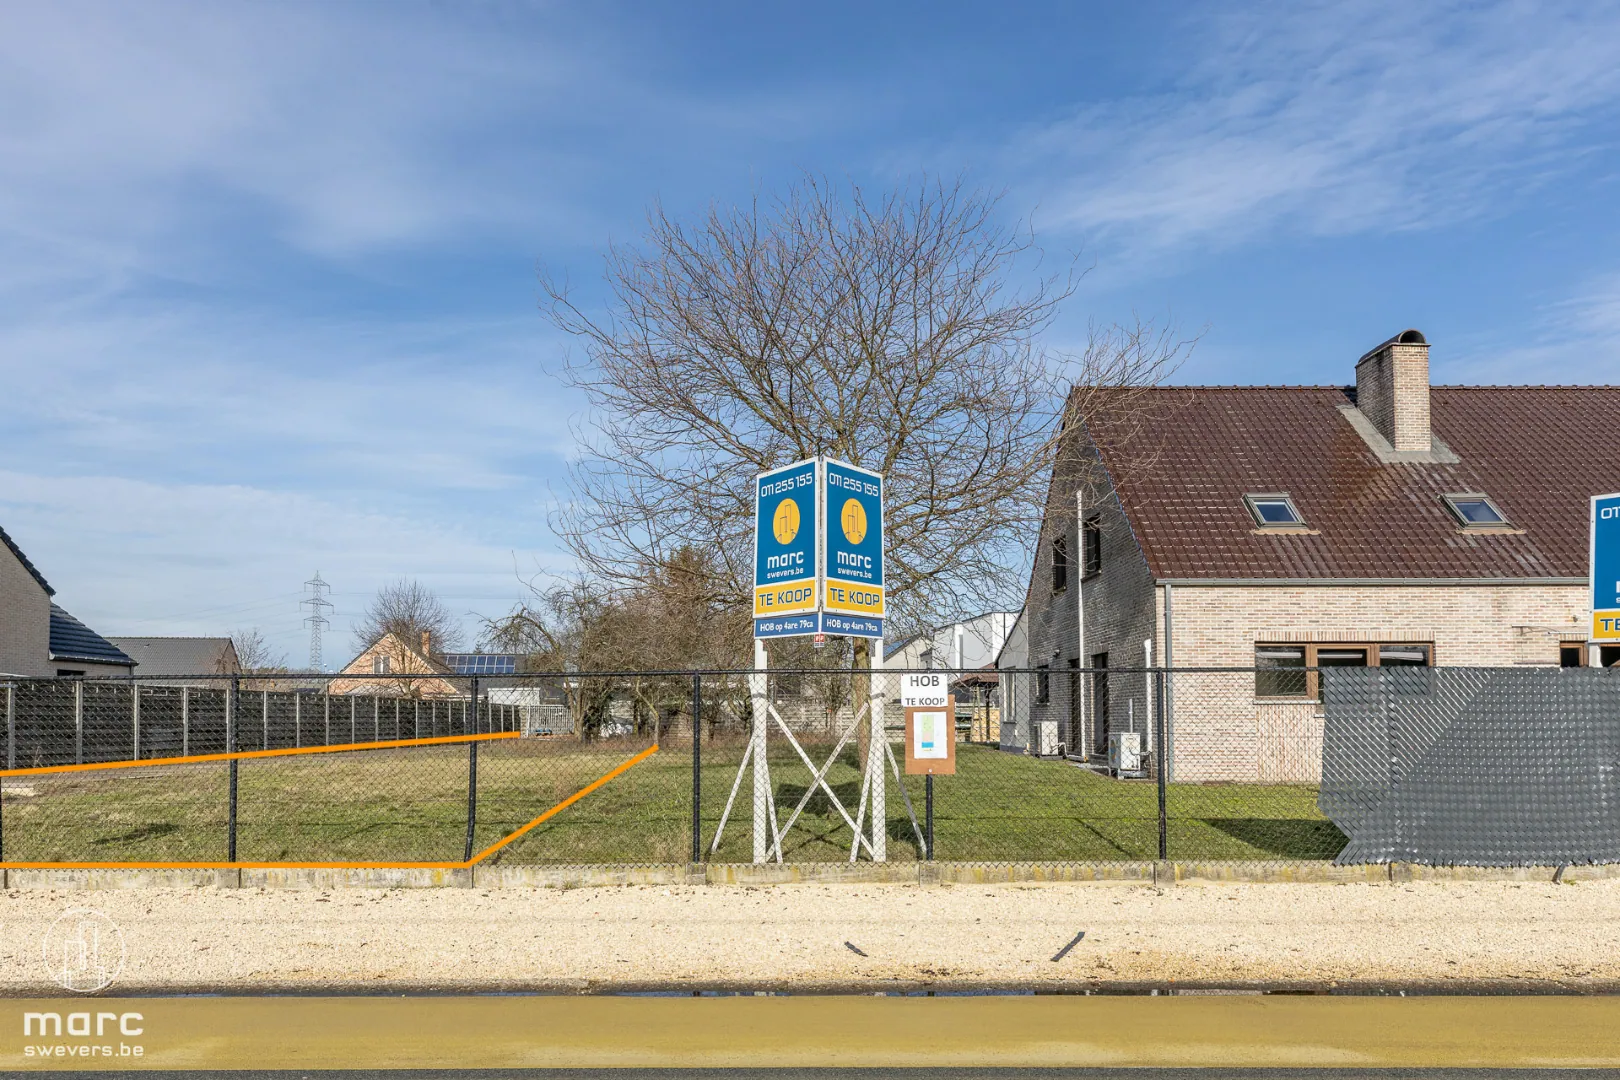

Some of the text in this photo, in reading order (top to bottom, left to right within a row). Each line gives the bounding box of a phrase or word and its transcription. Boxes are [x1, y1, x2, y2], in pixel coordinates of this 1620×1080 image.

[761, 472, 813, 498] 011 255 155
[828, 472, 879, 497] 011 255 155
[1601, 506, 1620, 519] 01
[767, 551, 804, 569] marc
[837, 551, 872, 569] marc
[767, 567, 804, 579] swevers.be
[838, 567, 872, 579] swevers.be
[759, 588, 812, 607] TE KOOP
[829, 588, 880, 607] TE KOOP
[760, 619, 814, 633] HOB op 4are 79ca
[826, 619, 878, 632] HOB op 4are 79ca
[910, 675, 940, 687] HOB
[905, 697, 945, 706] TE KOOP
